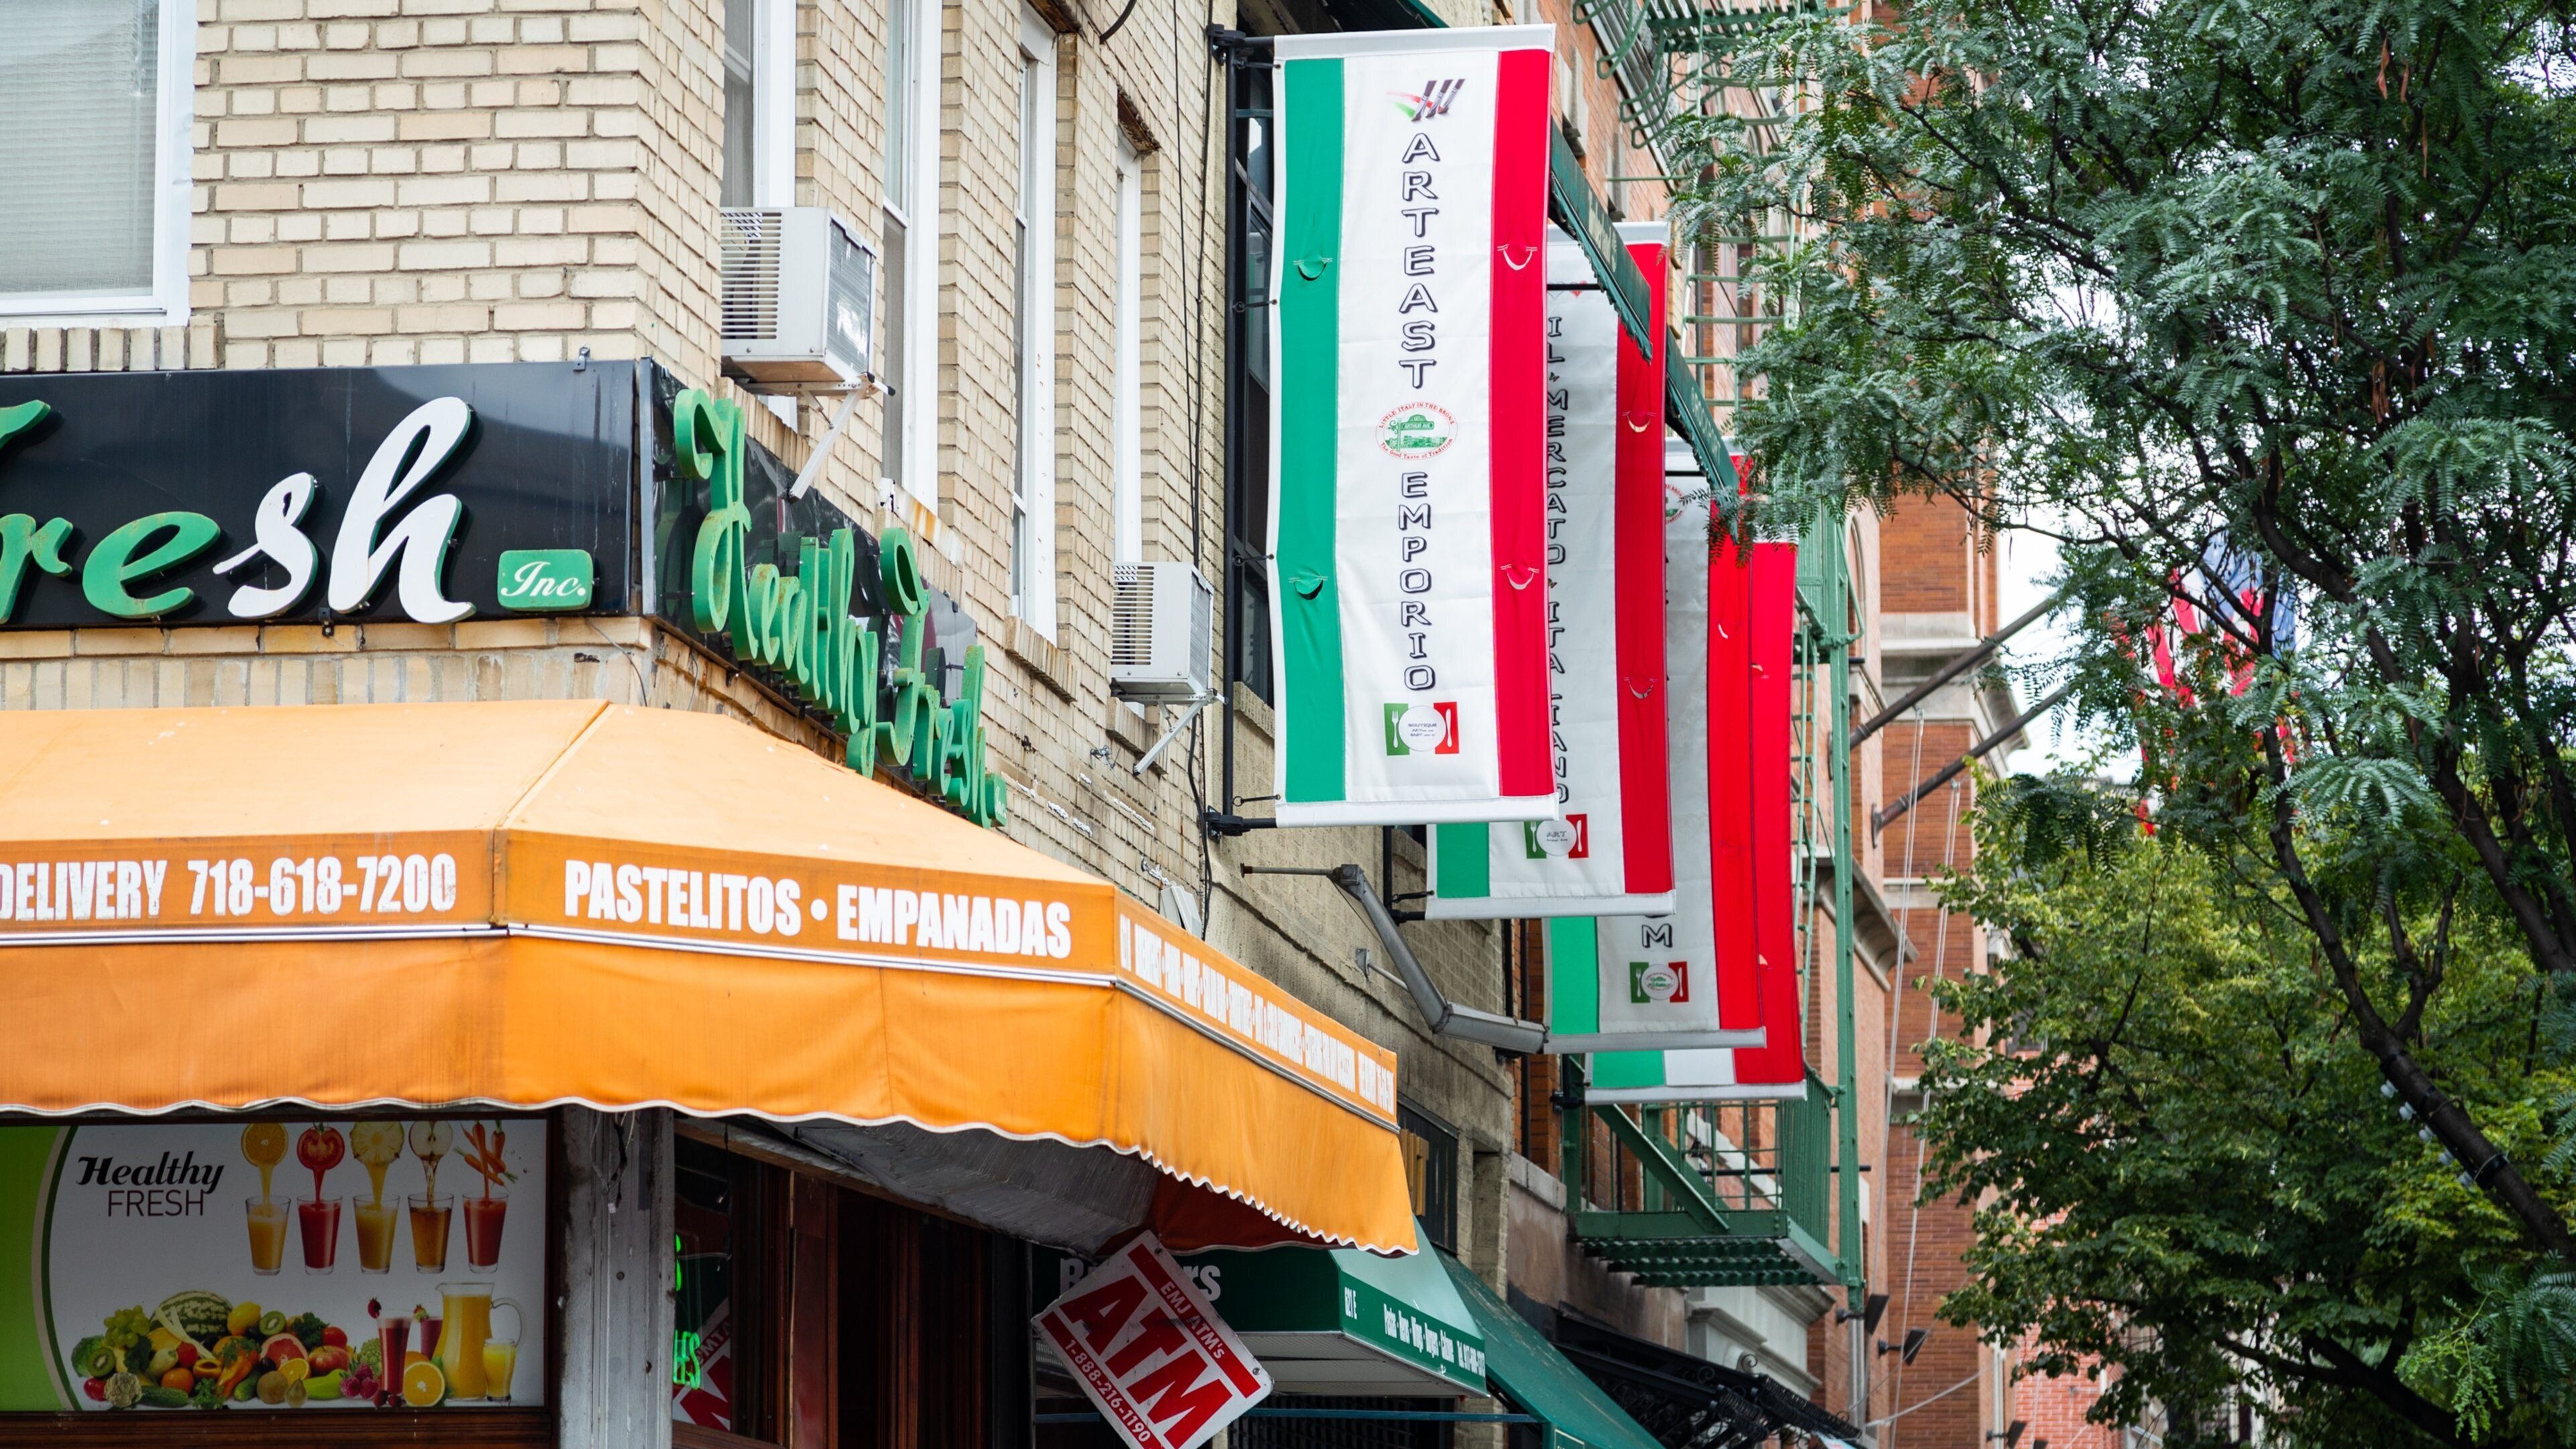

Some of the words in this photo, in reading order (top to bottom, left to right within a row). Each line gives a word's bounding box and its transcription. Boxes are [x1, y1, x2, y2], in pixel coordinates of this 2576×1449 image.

[1399, 132, 1440, 389] ARTEAST
[1379, 409, 1397, 429] LITTLE
[1398, 402, 1415, 413] ITALY
[1426, 402, 1438, 411] THE
[1438, 407, 1455, 425] BRONX
[1381, 442, 1389, 452] The
[1428, 438, 1454, 457] Tradition
[500, 560, 588, 598] Inc.
[1398, 471, 1436, 690] EMPORIO
[1548, 600, 1570, 805] ITAIANO
[187, 853, 458, 916] 718-618-7200
[564, 859, 802, 937] PASTELITOS
[837, 883, 1072, 959] EMPANADAS
[76, 1150, 225, 1195] Healthy
[107, 1189, 205, 1218] FRESH
[1160, 1281, 1186, 1315] EMJ
[1186, 1315, 1226, 1359] ATM's
[1059, 1275, 1233, 1449] ATM
[1065, 1340, 1151, 1442] 1-888-216-1190
